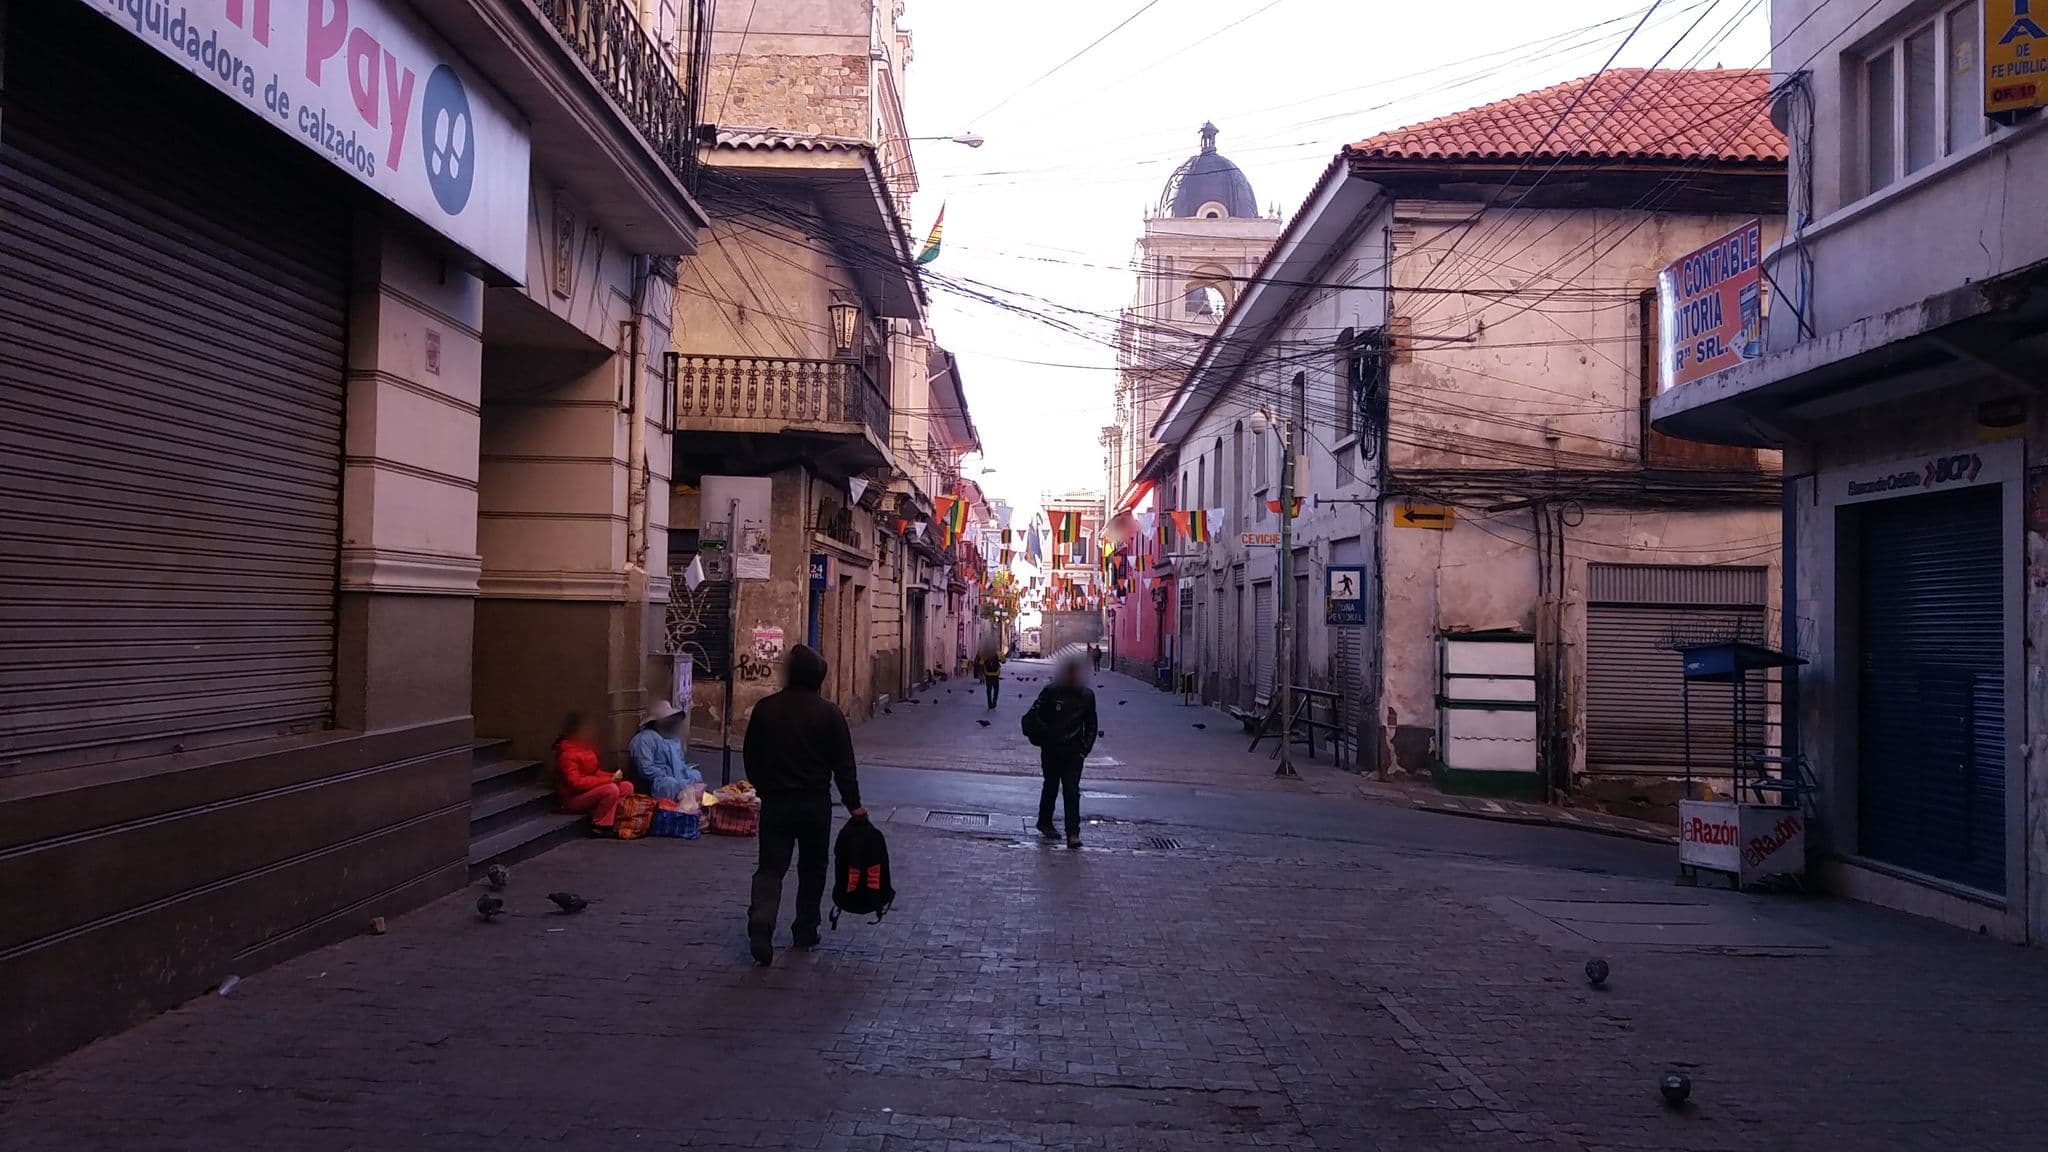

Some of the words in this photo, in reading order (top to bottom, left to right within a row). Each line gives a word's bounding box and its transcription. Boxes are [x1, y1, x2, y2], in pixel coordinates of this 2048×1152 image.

[104, 0, 254, 98] quidadora
[265, 74, 289, 119] de
[298, 105, 375, 178] calzados
[305, 0, 416, 172] Pay
[1991, 64, 2004, 79] FE
[2007, 58, 2048, 76] PUBLIC
[1684, 228, 1758, 298] CONTABLE
[1671, 291, 1723, 345] DITORIA
[1696, 335, 1729, 364] SRL.
[1241, 533, 1281, 544] CEVICHE
[810, 564, 823, 573] 24
